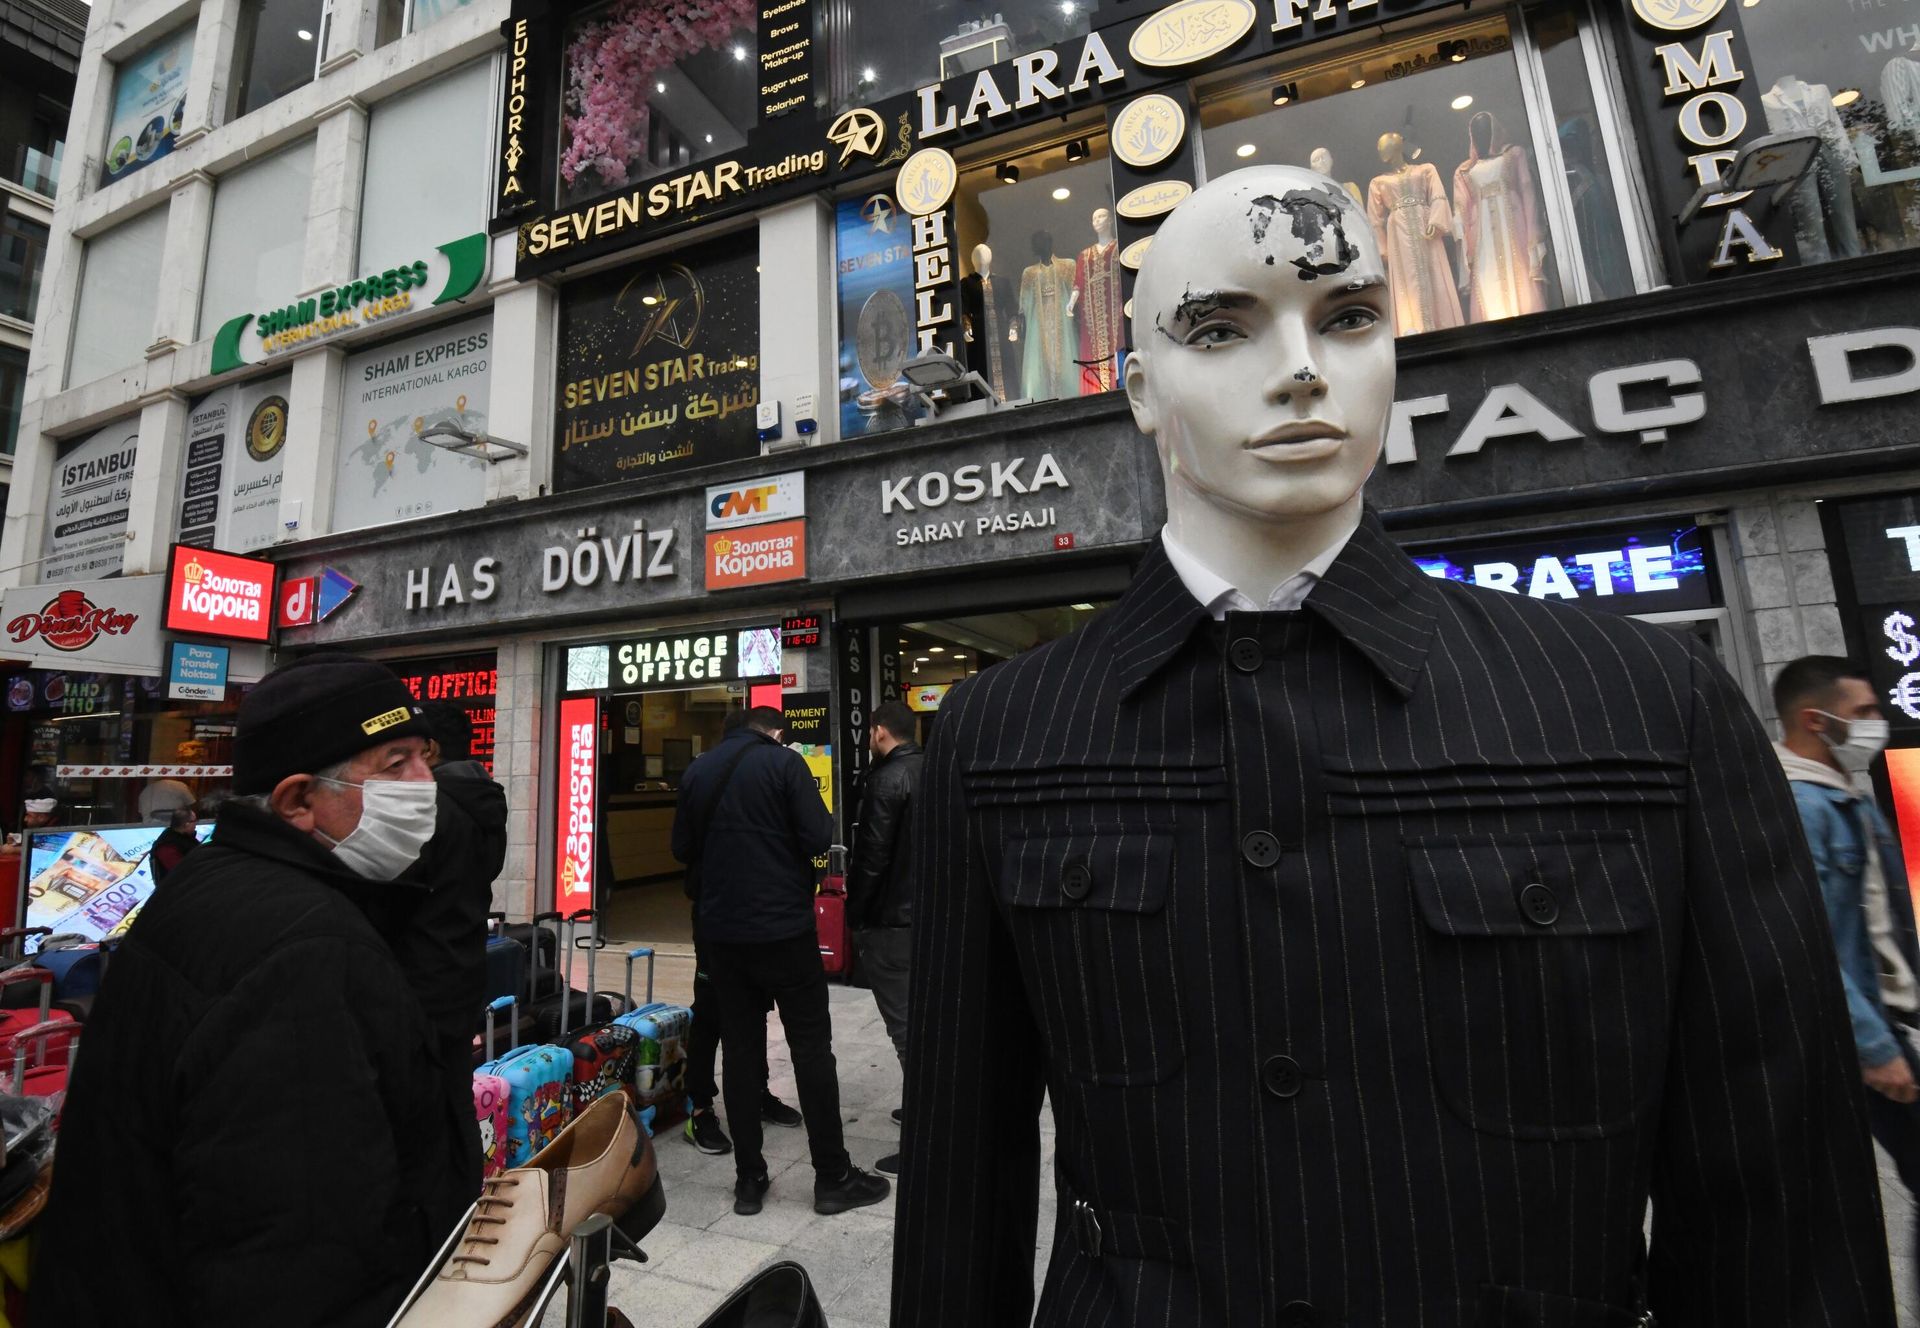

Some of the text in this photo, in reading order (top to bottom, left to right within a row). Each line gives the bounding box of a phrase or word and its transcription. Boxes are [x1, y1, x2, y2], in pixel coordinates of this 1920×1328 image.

[770, 22, 799, 38] Brows
[761, 38, 810, 63] Permanent
[764, 51, 804, 70] Make-up
[761, 72, 809, 95] Sugar wax
[917, 32, 1125, 140] LARA
[766, 94, 805, 114] Solarium
[1655, 30, 1784, 269] MODA
[529, 150, 824, 255] SEVEN STAR Trading
[256, 260, 428, 338] SHAM EXPRESS
[912, 210, 955, 400] HELL
[262, 292, 413, 352] INTERNATIONAL KARGO
[364, 332, 489, 382] SHAM EXPRESS
[362, 360, 487, 404] INTERNATIONAL KARGO
[564, 353, 758, 409] SEVEN STAR Trading
[685, 381, 757, 420] شركة
[562, 416, 614, 451] ستار
[620, 403, 678, 437] سفن
[881, 453, 1070, 515] KOSKA
[711, 485, 778, 518] CMT
[896, 507, 1057, 547] SARAY PASAJI
[1058, 536, 1070, 547] 33
[715, 549, 794, 577] Корона
[732, 536, 793, 556] Золотая
[405, 519, 676, 611] HAS DÖVİZ
[1473, 545, 1679, 600] RATE
[202, 569, 262, 598] Золотая
[182, 582, 260, 621] Корона
[6, 607, 139, 643] Döner King
[180, 657, 219, 670] Transfer
[189, 647, 212, 658] Para
[618, 635, 728, 665] CHANGE
[180, 668, 217, 680] Noktası
[622, 656, 722, 684] OFFICE
[883, 653, 896, 703] CHA
[178, 686, 215, 696] GönderAL
[784, 707, 826, 719] PAYMENT
[791, 719, 820, 730] POINT
[566, 725, 581, 854] Золотая
[573, 723, 593, 893] Корона
[93, 883, 137, 912] 500
